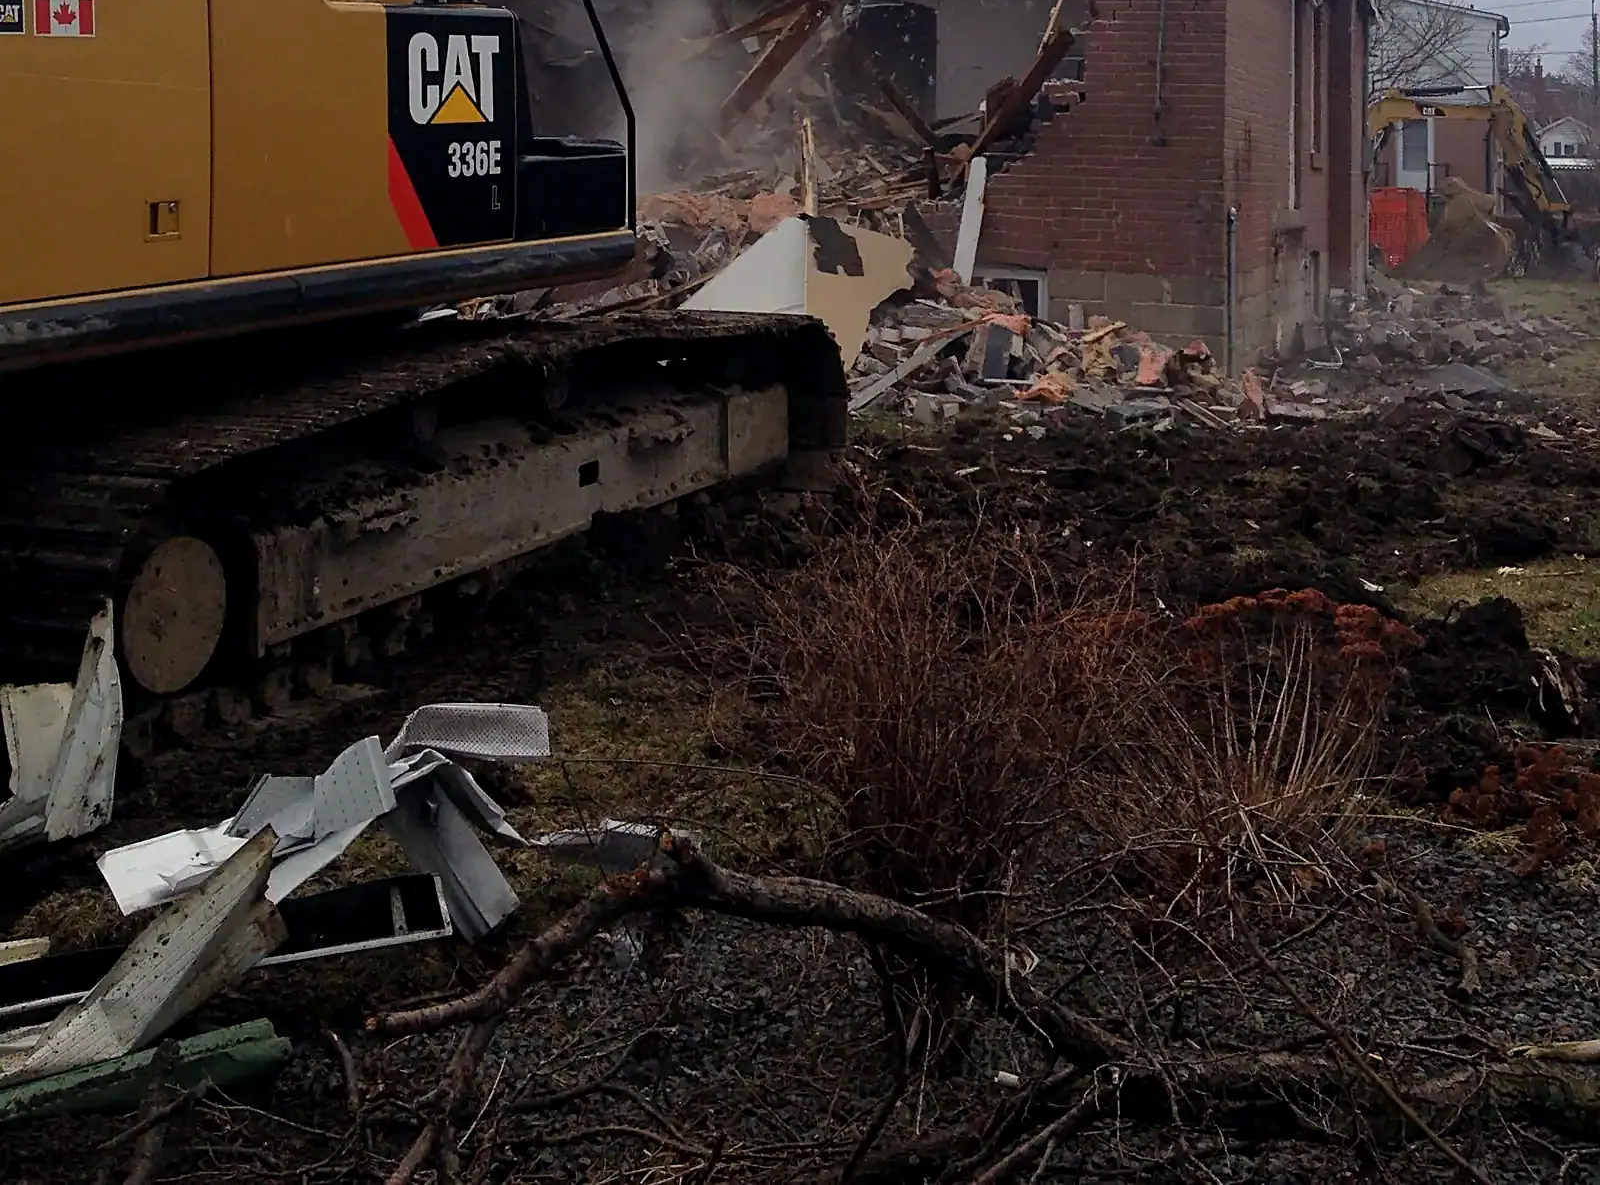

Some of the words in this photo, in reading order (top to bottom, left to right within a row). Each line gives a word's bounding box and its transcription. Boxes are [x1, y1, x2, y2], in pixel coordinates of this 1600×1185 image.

[408, 32, 500, 125] CAT
[1423, 107, 1436, 115] CAT
[448, 140, 501, 178] 336E
[491, 185, 501, 210] L
